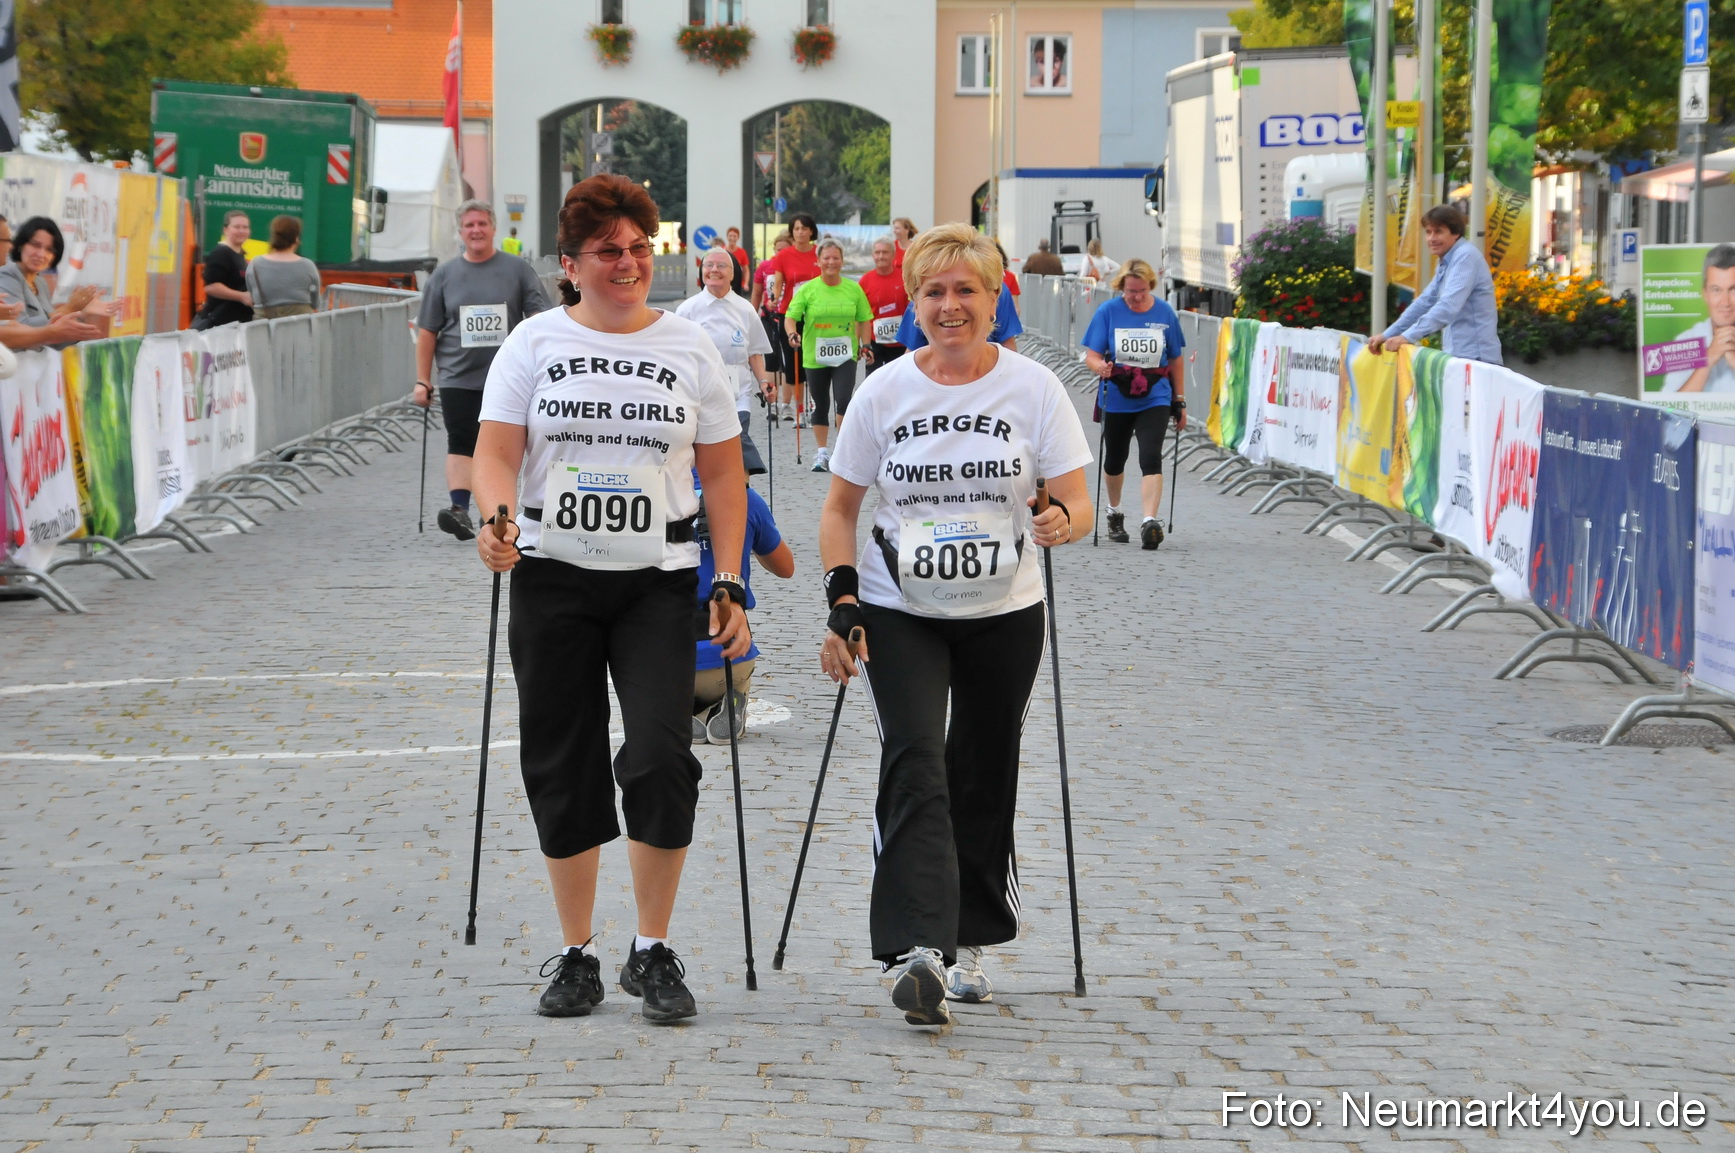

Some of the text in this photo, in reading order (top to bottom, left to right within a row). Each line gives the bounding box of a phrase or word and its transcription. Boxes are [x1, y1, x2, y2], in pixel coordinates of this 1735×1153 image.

[1260, 112, 1366, 147] BOC
[214, 164, 290, 181] Neumarkter
[206, 179, 303, 199] ammsbräu
[1645, 278, 1693, 288] Anpacken.
[1645, 290, 1702, 299] Entscheiden.
[1645, 302, 1674, 311] Lösen.
[466, 316, 502, 332] 8022
[878, 323, 900, 336] 8045
[472, 334, 498, 342] Gerhard
[820, 344, 848, 357] 8068
[1121, 339, 1157, 353] 8050
[1663, 340, 1700, 353] WERNER
[1128, 355, 1150, 364] Margit
[547, 357, 677, 391] BERGER
[537, 398, 685, 424] POWER GIRLS
[893, 414, 1012, 444] BERGER
[545, 432, 670, 454] walking and talking
[886, 458, 1022, 483] POWER GIRLS
[578, 472, 629, 486] BOCK
[895, 493, 939, 507] walking
[943, 493, 965, 503] and
[556, 492, 652, 533] 8090
[934, 521, 979, 536] BOCK
[913, 541, 1001, 581] 8087
[932, 587, 982, 601] Carmen
